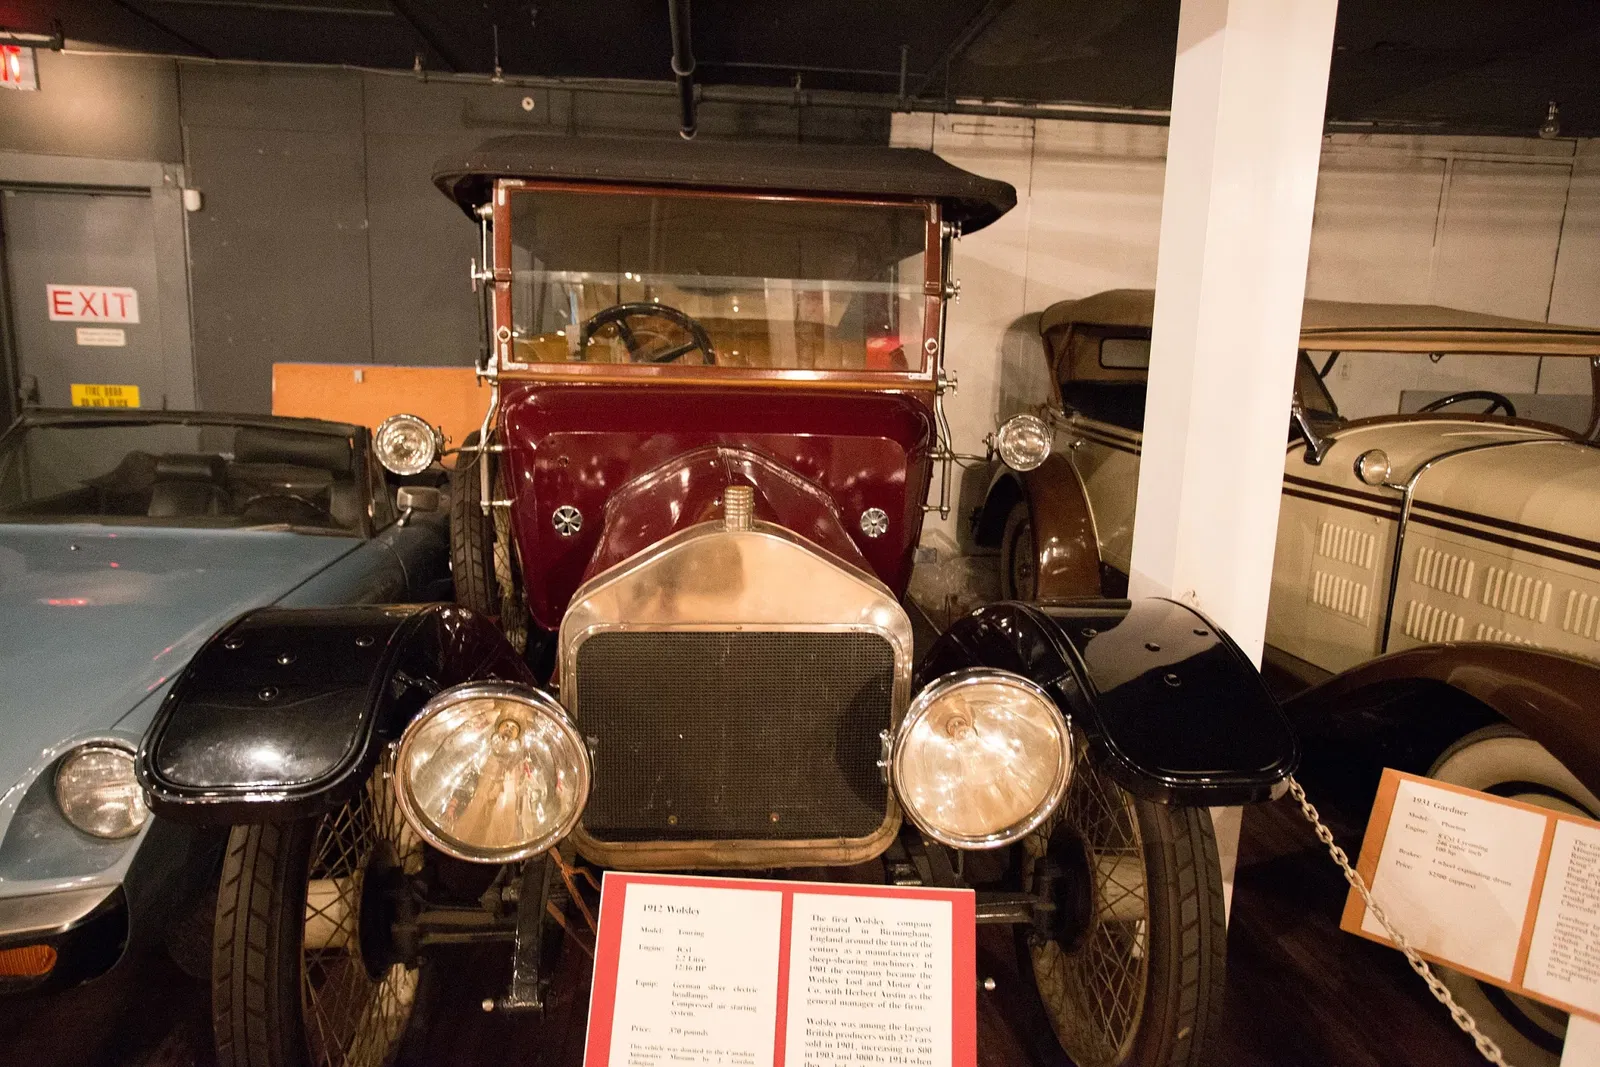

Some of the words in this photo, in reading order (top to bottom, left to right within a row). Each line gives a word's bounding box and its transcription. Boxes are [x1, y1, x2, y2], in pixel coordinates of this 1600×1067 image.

[53, 290, 132, 318] EXIT
[1412, 796, 1430, 806] 1931
[1434, 802, 1468, 816] Gardner
[644, 904, 663, 912] 1912
[667, 905, 700, 916] Wolsley
[854, 916, 884, 925] Wolsley
[896, 921, 932, 929] company
[678, 929, 704, 938] Touring
[810, 926, 850, 935] originated
[810, 934, 843, 944] England
[845, 937, 874, 946] around
[809, 946, 838, 954] century
[866, 949, 920, 958] manufacturer
[809, 956, 868, 966] sheep-shearing
[846, 969, 882, 977] company
[886, 970, 916, 978] became
[672, 982, 700, 990] German
[708, 983, 726, 992] silver
[733, 985, 758, 994] electric
[808, 976, 838, 984] Wolsley
[846, 978, 862, 986] Tool
[888, 980, 911, 988] Motor
[825, 988, 842, 996] with
[846, 988, 876, 997] Herbert
[882, 990, 906, 998] Austin
[671, 1000, 713, 1010] Compressed
[730, 1004, 757, 1013] starting
[806, 998, 836, 1006] general
[840, 1000, 874, 1009] manager
[806, 1018, 837, 1026] Wolsley
[859, 1022, 886, 1031] among
[904, 1024, 932, 1032] largest
[684, 1028, 708, 1037] pounds
[806, 1028, 833, 1037] British
[836, 1032, 876, 1040] producers
[879, 1033, 896, 1041] with
[862, 1044, 902, 1054] increasing
[876, 1054, 884, 1063] by
[890, 1056, 907, 1064] 1914
[910, 1058, 932, 1066] when
